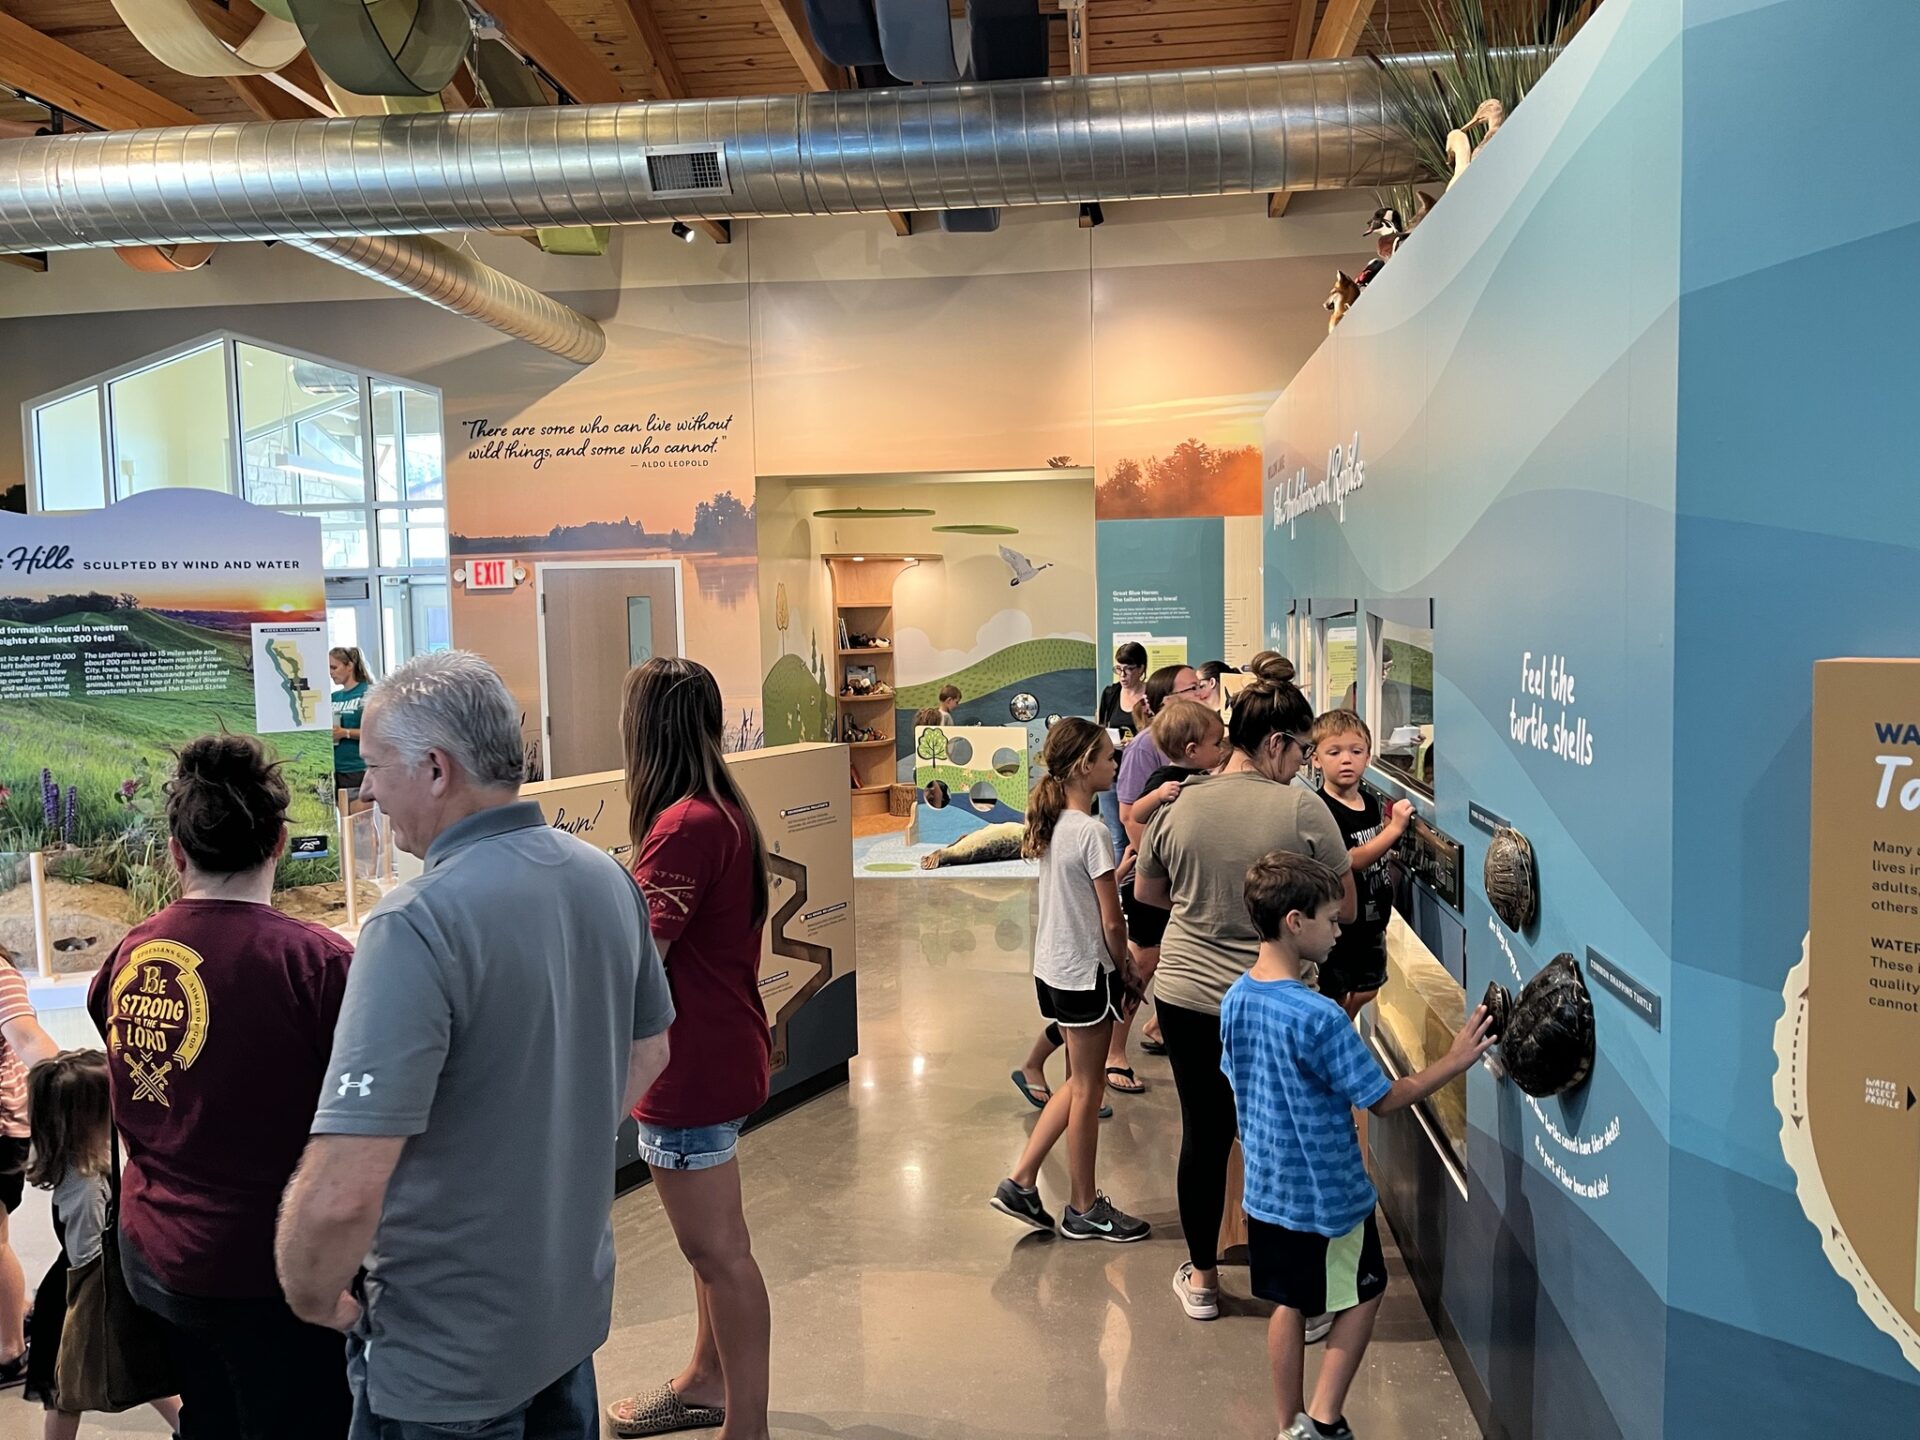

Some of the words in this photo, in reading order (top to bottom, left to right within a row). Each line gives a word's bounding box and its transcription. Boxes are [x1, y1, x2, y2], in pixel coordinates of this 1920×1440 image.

[462, 419, 508, 439] "There
[512, 425, 535, 437] are
[540, 424, 575, 436] some
[579, 415, 610, 434] who
[613, 422, 642, 433] can
[646, 413, 671, 432] live
[676, 412, 733, 431] without
[468, 441, 502, 460] wild
[504, 440, 552, 470] things,
[556, 438, 590, 457] and
[590, 443, 625, 456] some
[630, 436, 660, 455] who
[668, 460, 709, 468] LEOPOLD
[7, 545, 75, 574] Hills
[83, 561, 157, 570] SCULPTED
[162, 561, 178, 569] BY
[182, 561, 219, 569] WIND
[224, 561, 252, 569] AND
[256, 560, 300, 569] WATER
[474, 561, 505, 586] EXIT
[7, 625, 52, 634] formation
[54, 625, 80, 633] found
[92, 624, 128, 632] western
[39, 636, 71, 644] almost
[73, 635, 91, 643] 200
[93, 634, 115, 642] feet!
[1522, 651, 1546, 699] Feel
[1550, 654, 1575, 706] the
[1510, 697, 1549, 750] turtle
[1552, 711, 1593, 766] shells
[1873, 840, 1912, 857] Many
[1872, 860, 1906, 874] lives
[1871, 899, 1918, 915] others
[1870, 955, 1913, 973] These
[1869, 976, 1920, 995] quality
[121, 994, 184, 1021] STRONG
[1633, 991, 1652, 1013] TURTLE
[1869, 996, 1918, 1012] cannot
[142, 1018, 158, 1029] THE
[126, 1024, 167, 1052] LORD
[1865, 1077, 1896, 1091] WATER
[1865, 1087, 1897, 1100] INSECT
[1865, 1095, 1900, 1109] PROFILE
